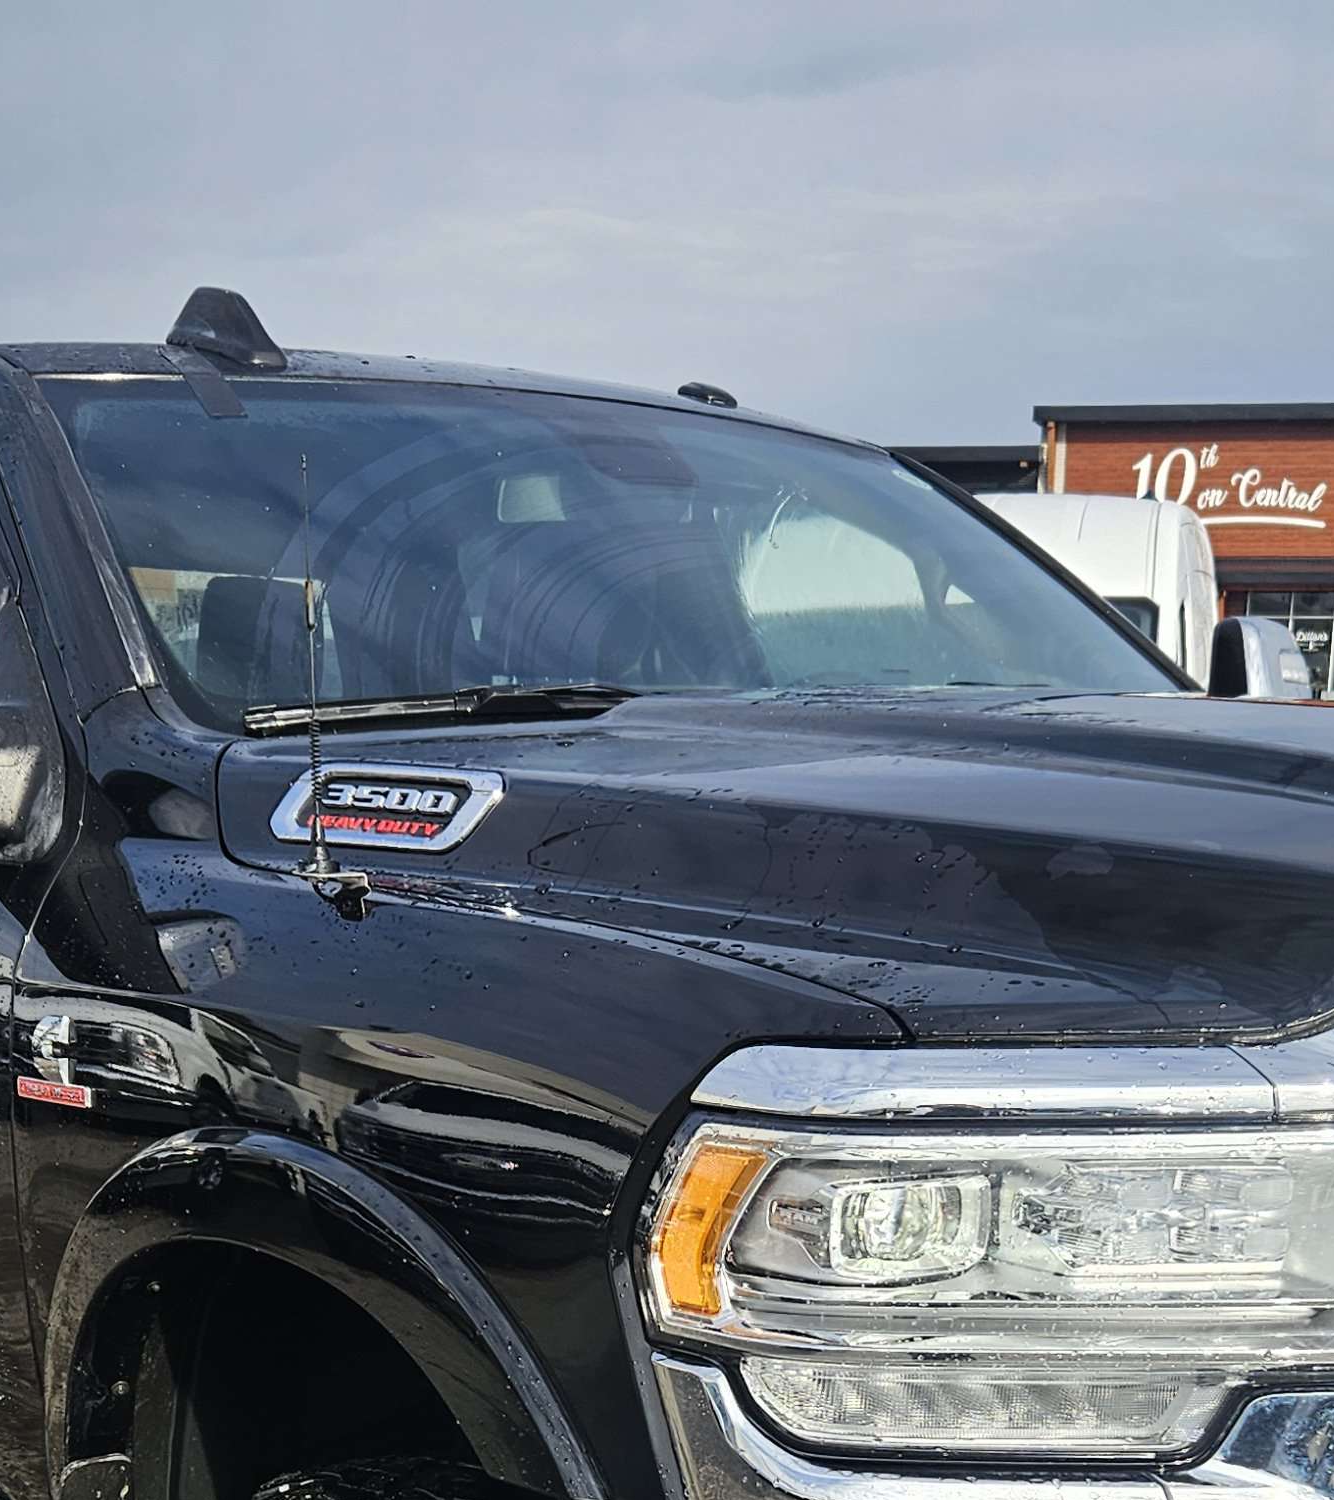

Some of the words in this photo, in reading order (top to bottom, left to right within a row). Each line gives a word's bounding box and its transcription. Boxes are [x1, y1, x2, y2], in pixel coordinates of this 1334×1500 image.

[1197, 488, 1228, 510] on
[1230, 468, 1328, 512] Central
[321, 783, 459, 814] 3500
[376, 818, 439, 836] DUTY
